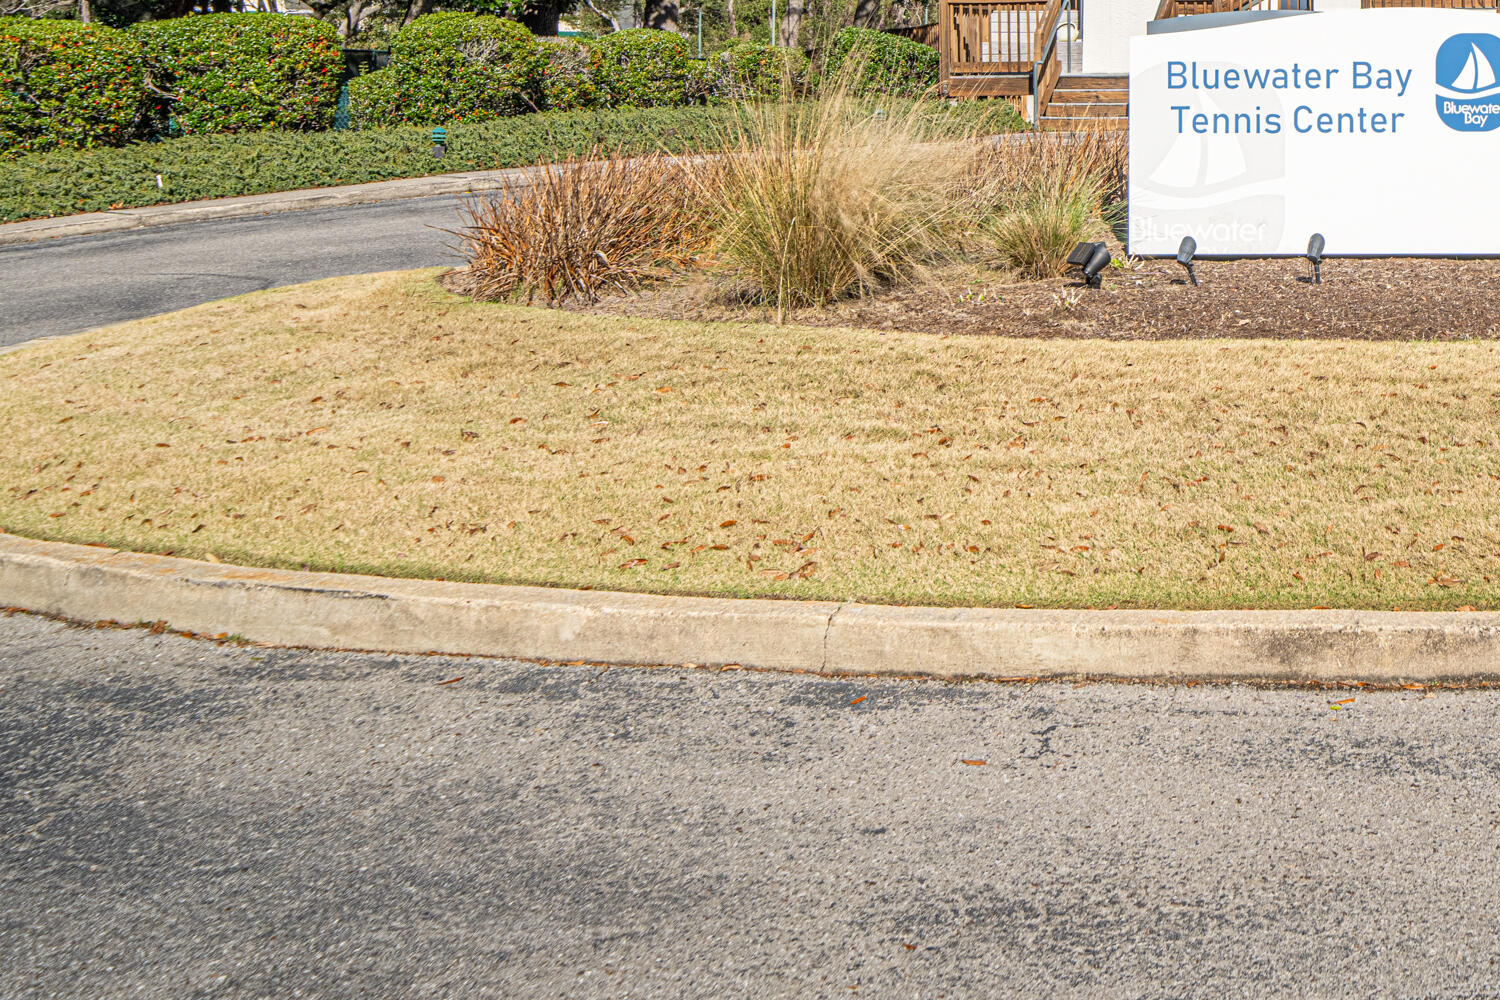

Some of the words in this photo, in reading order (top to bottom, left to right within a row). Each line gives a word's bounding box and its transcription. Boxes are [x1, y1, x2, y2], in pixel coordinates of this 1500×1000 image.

[1167, 60, 1340, 89] Bluewater
[1352, 60, 1413, 97] Bay
[1170, 105, 1282, 134] Tennis
[1293, 104, 1406, 134] Center
[1464, 112, 1489, 128] Bay
